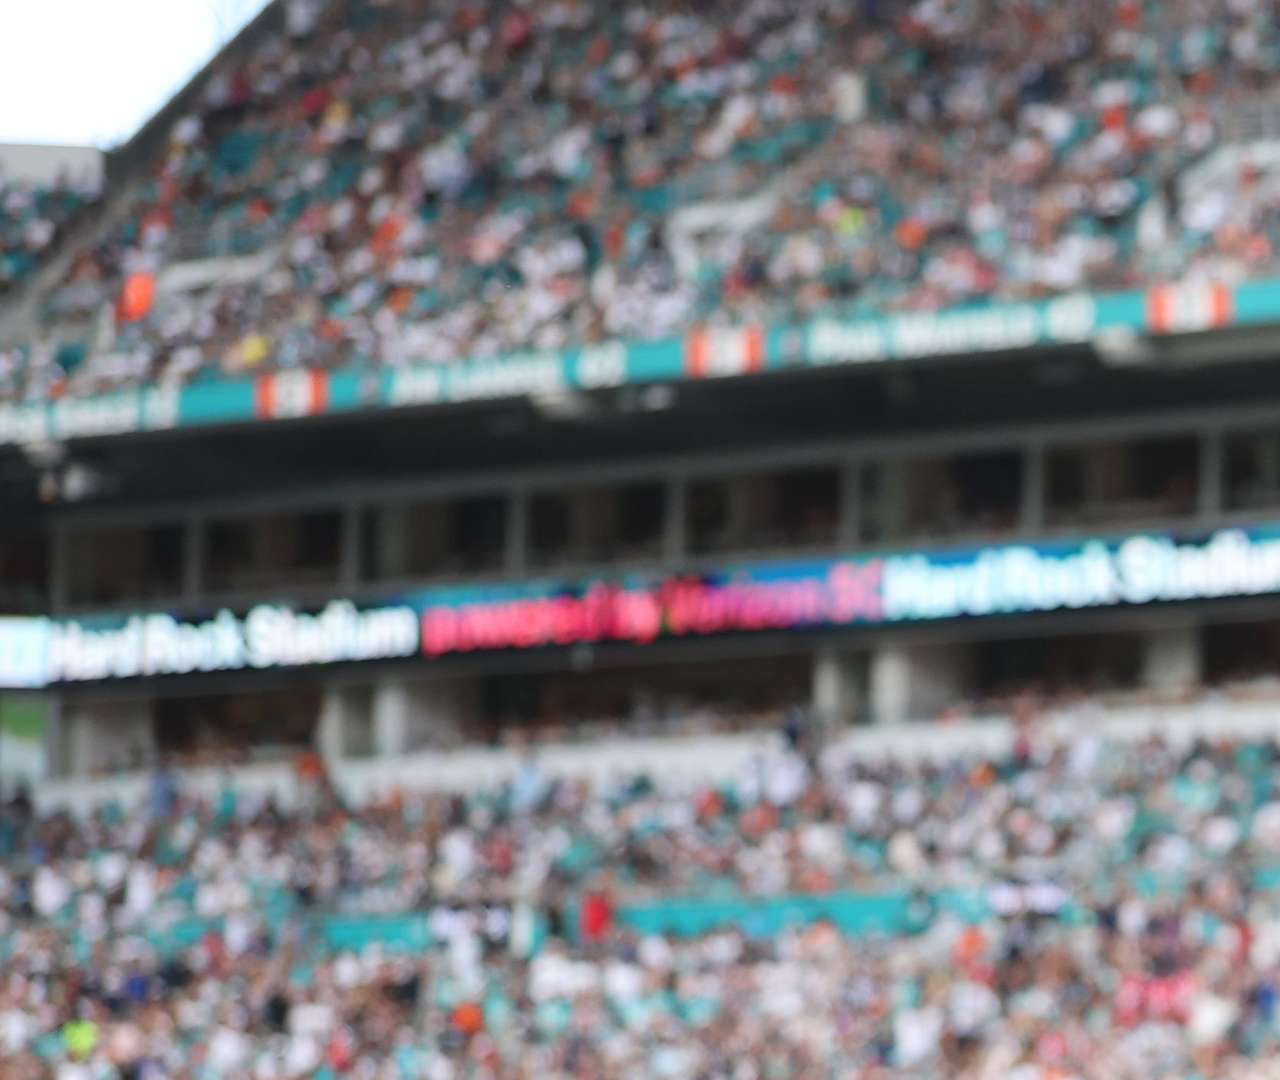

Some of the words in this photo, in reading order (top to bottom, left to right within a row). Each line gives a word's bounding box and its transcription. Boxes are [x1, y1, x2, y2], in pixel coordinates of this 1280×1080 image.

[883, 548, 998, 622] Hard
[999, 540, 1116, 614] Rock
[47, 613, 143, 683] Hard
[143, 607, 245, 677] Rock
[245, 598, 419, 669] Stadium
